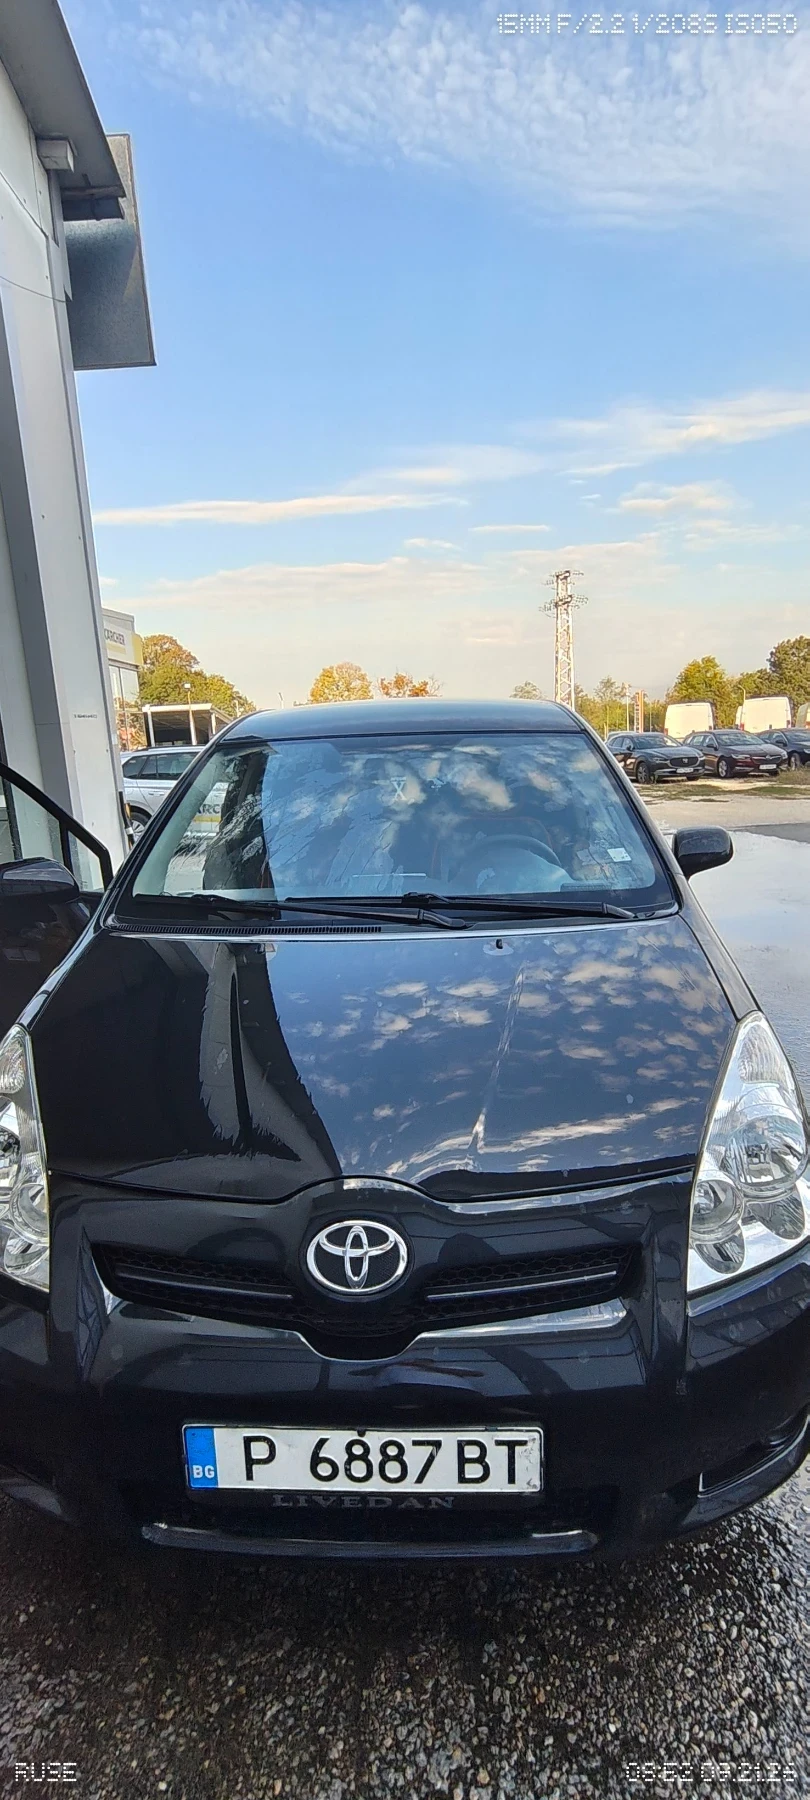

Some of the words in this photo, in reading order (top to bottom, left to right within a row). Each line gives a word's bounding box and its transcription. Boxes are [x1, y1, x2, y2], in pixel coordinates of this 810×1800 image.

[242, 1435, 277, 1482] P
[309, 1436, 443, 1484] 6887
[456, 1439, 528, 1485] BT
[192, 1464, 215, 1479] BG
[272, 1494, 455, 1510] LIVEDAN
